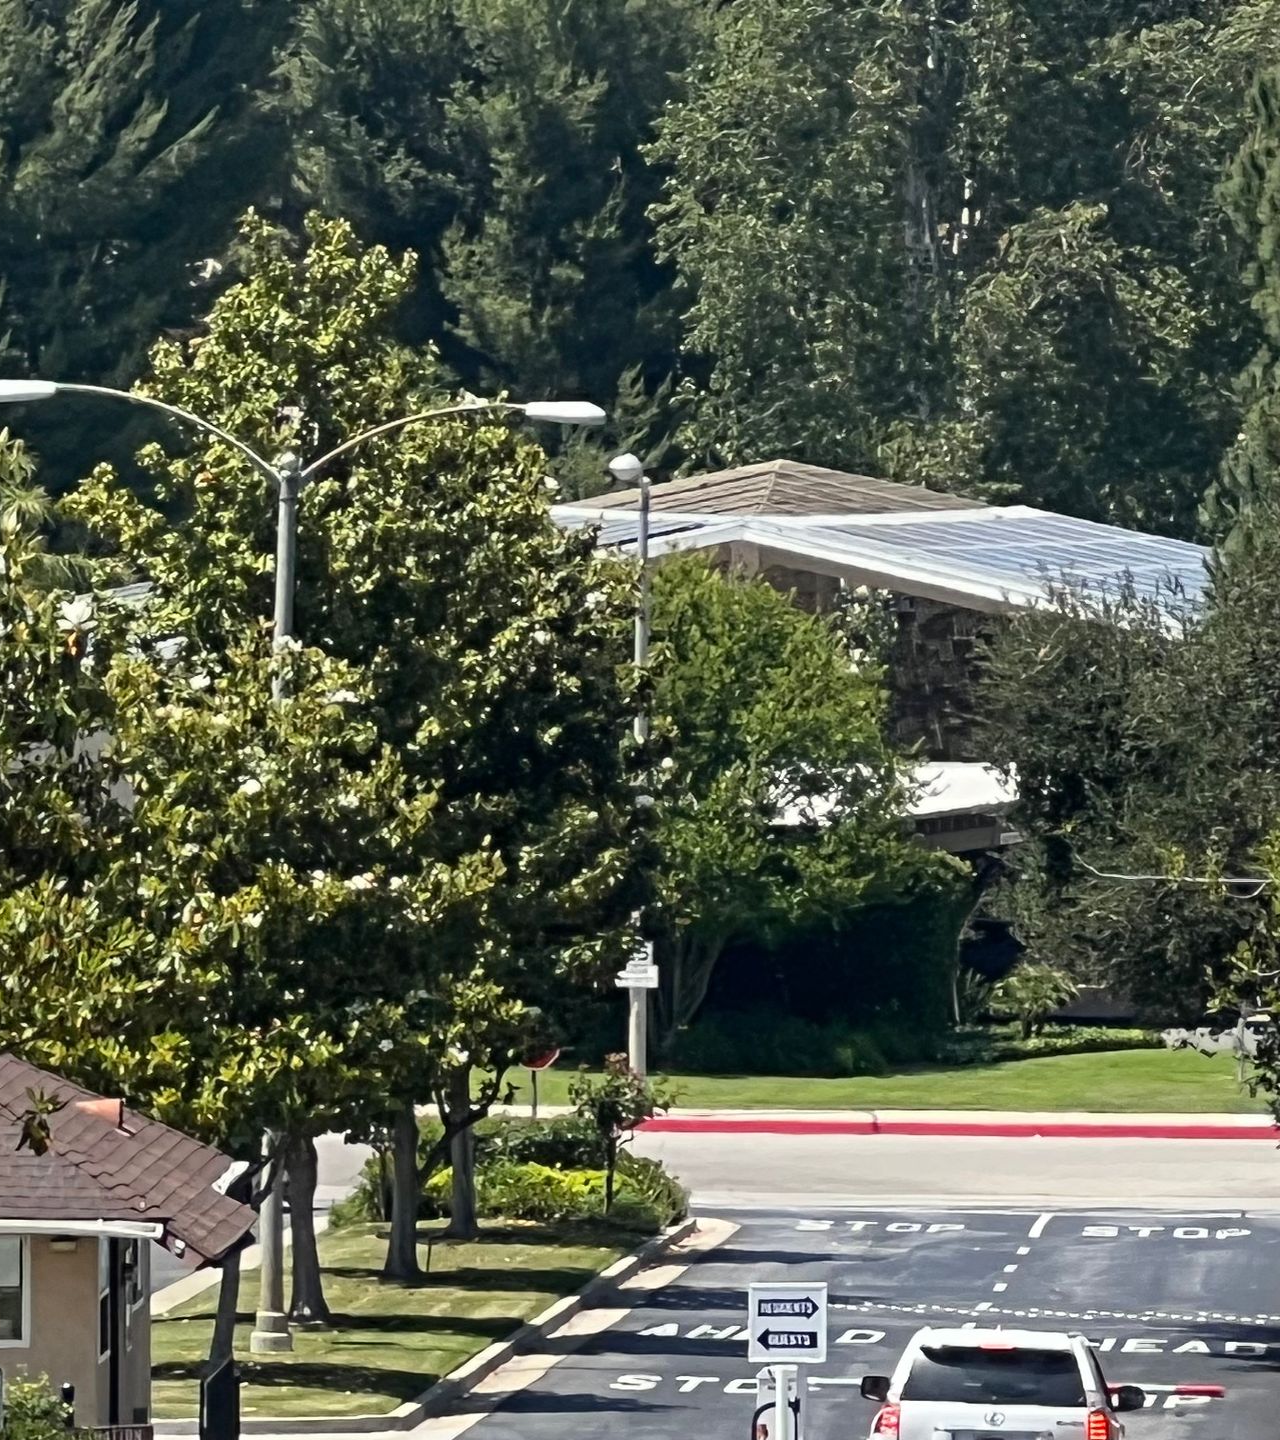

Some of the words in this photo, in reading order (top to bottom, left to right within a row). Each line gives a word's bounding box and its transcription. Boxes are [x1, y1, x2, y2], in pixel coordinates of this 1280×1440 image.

[795, 1219, 966, 1234] STOP
[1081, 1225, 1252, 1240] STOP
[638, 1322, 886, 1345] AHD
[1089, 1337, 1268, 1356] HEAD
[609, 1374, 821, 1394] STO
